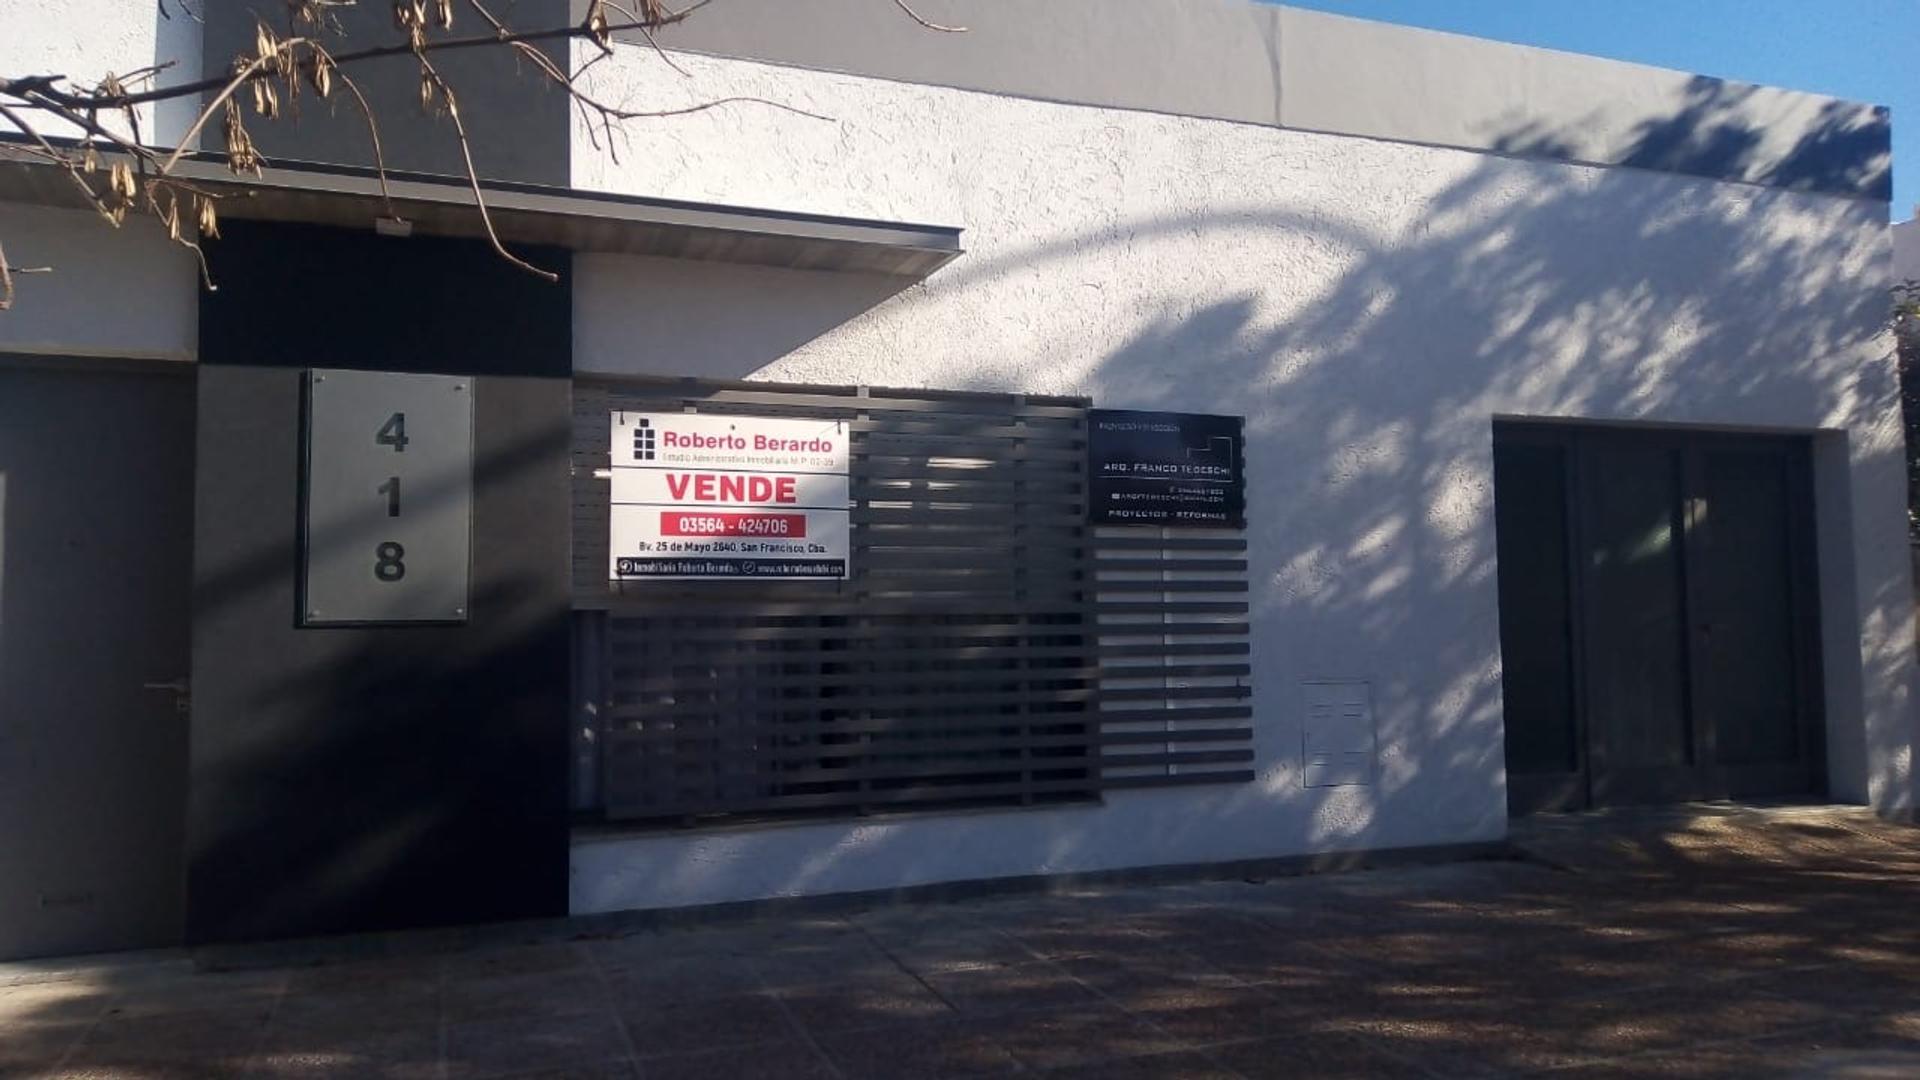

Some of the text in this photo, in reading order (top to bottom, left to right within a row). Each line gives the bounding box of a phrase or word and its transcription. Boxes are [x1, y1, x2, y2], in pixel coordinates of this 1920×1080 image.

[663, 431, 832, 453] Roberto Berardo
[1134, 464, 1178, 473] FRANCO
[1181, 466, 1231, 475] TEDESCHI
[666, 474, 797, 504] VENDE
[679, 517, 725, 532] 03564
[738, 518, 788, 534] 424706
[656, 542, 667, 551] 25
[671, 542, 682, 551] de
[684, 542, 711, 553] Mayo
[741, 543, 757, 552] San
